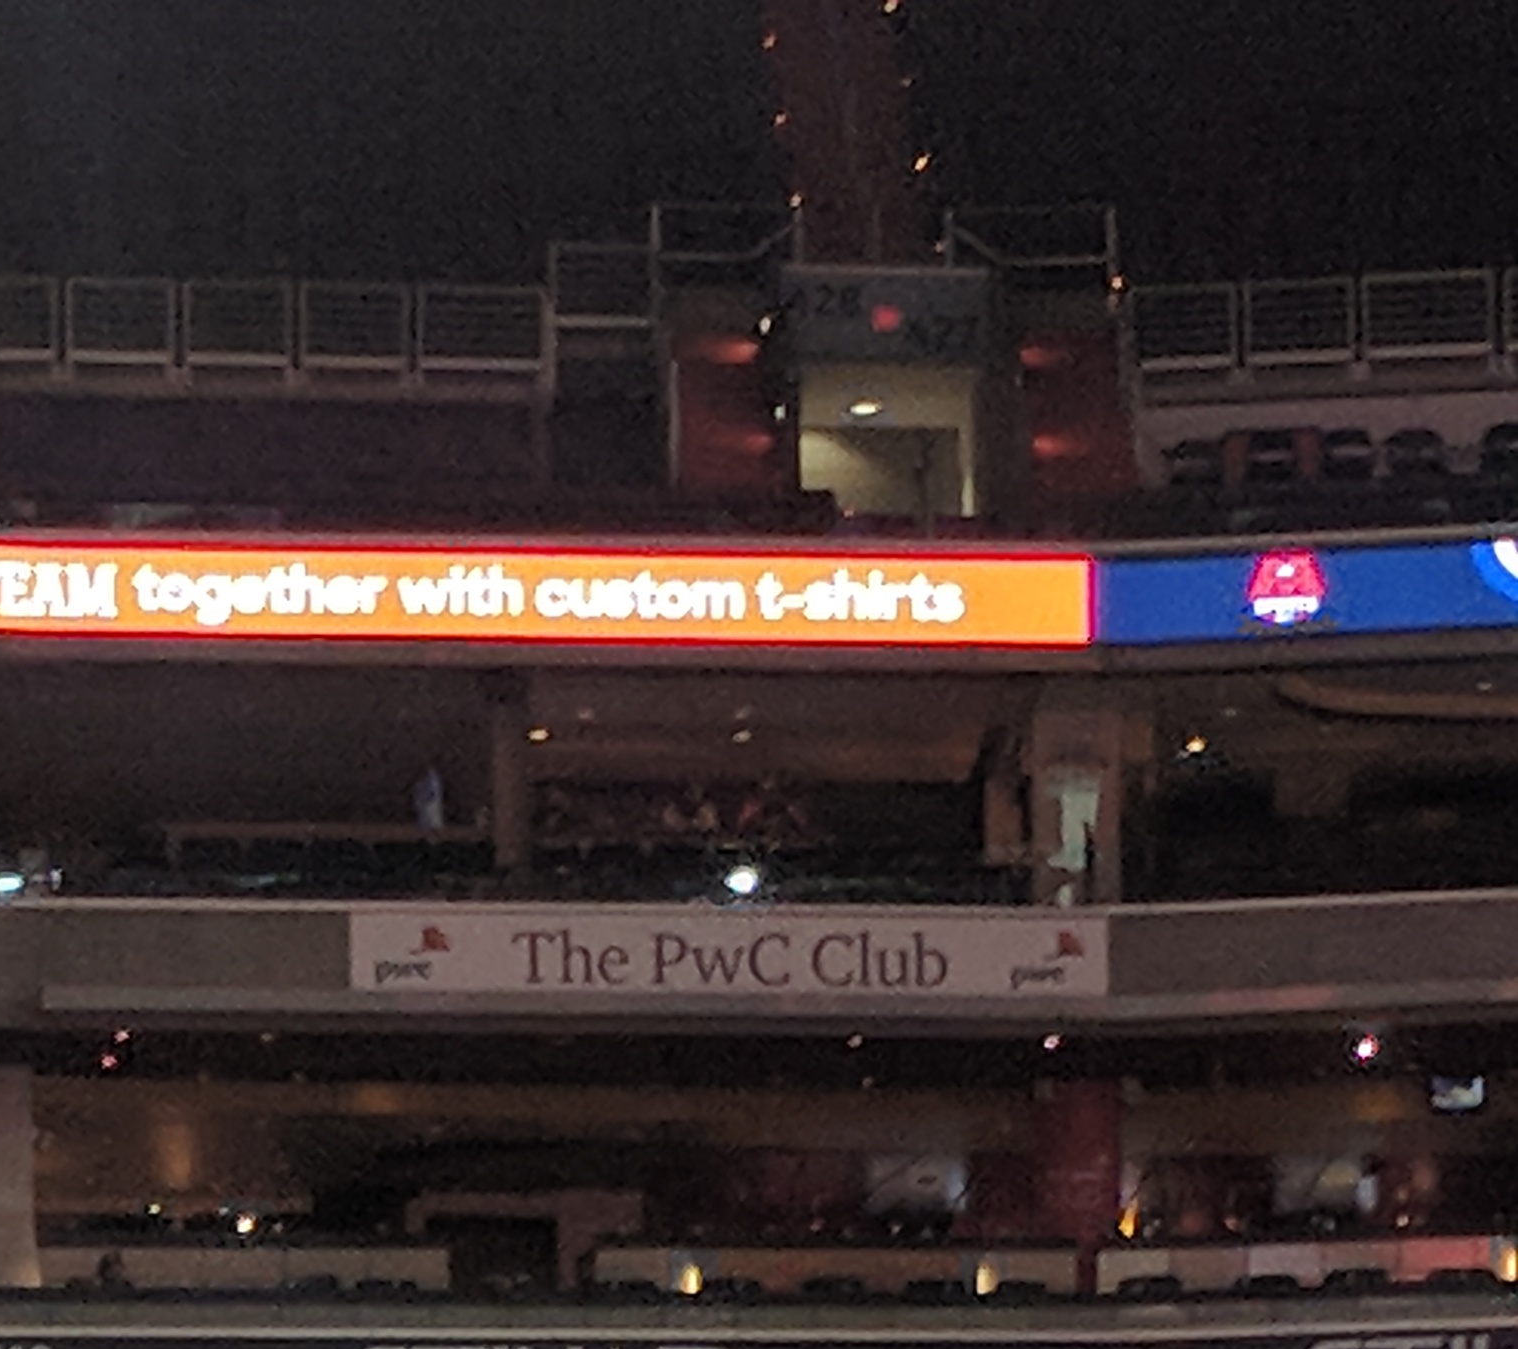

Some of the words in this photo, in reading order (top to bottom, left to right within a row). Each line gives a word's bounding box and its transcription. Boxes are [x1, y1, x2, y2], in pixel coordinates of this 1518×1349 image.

[132, 564, 387, 626] together
[398, 565, 525, 616] with
[534, 571, 746, 620] custom
[755, 569, 966, 622] t-shirts
[512, 932, 630, 985] The
[651, 934, 790, 987] PwC
[810, 932, 949, 987] Club
